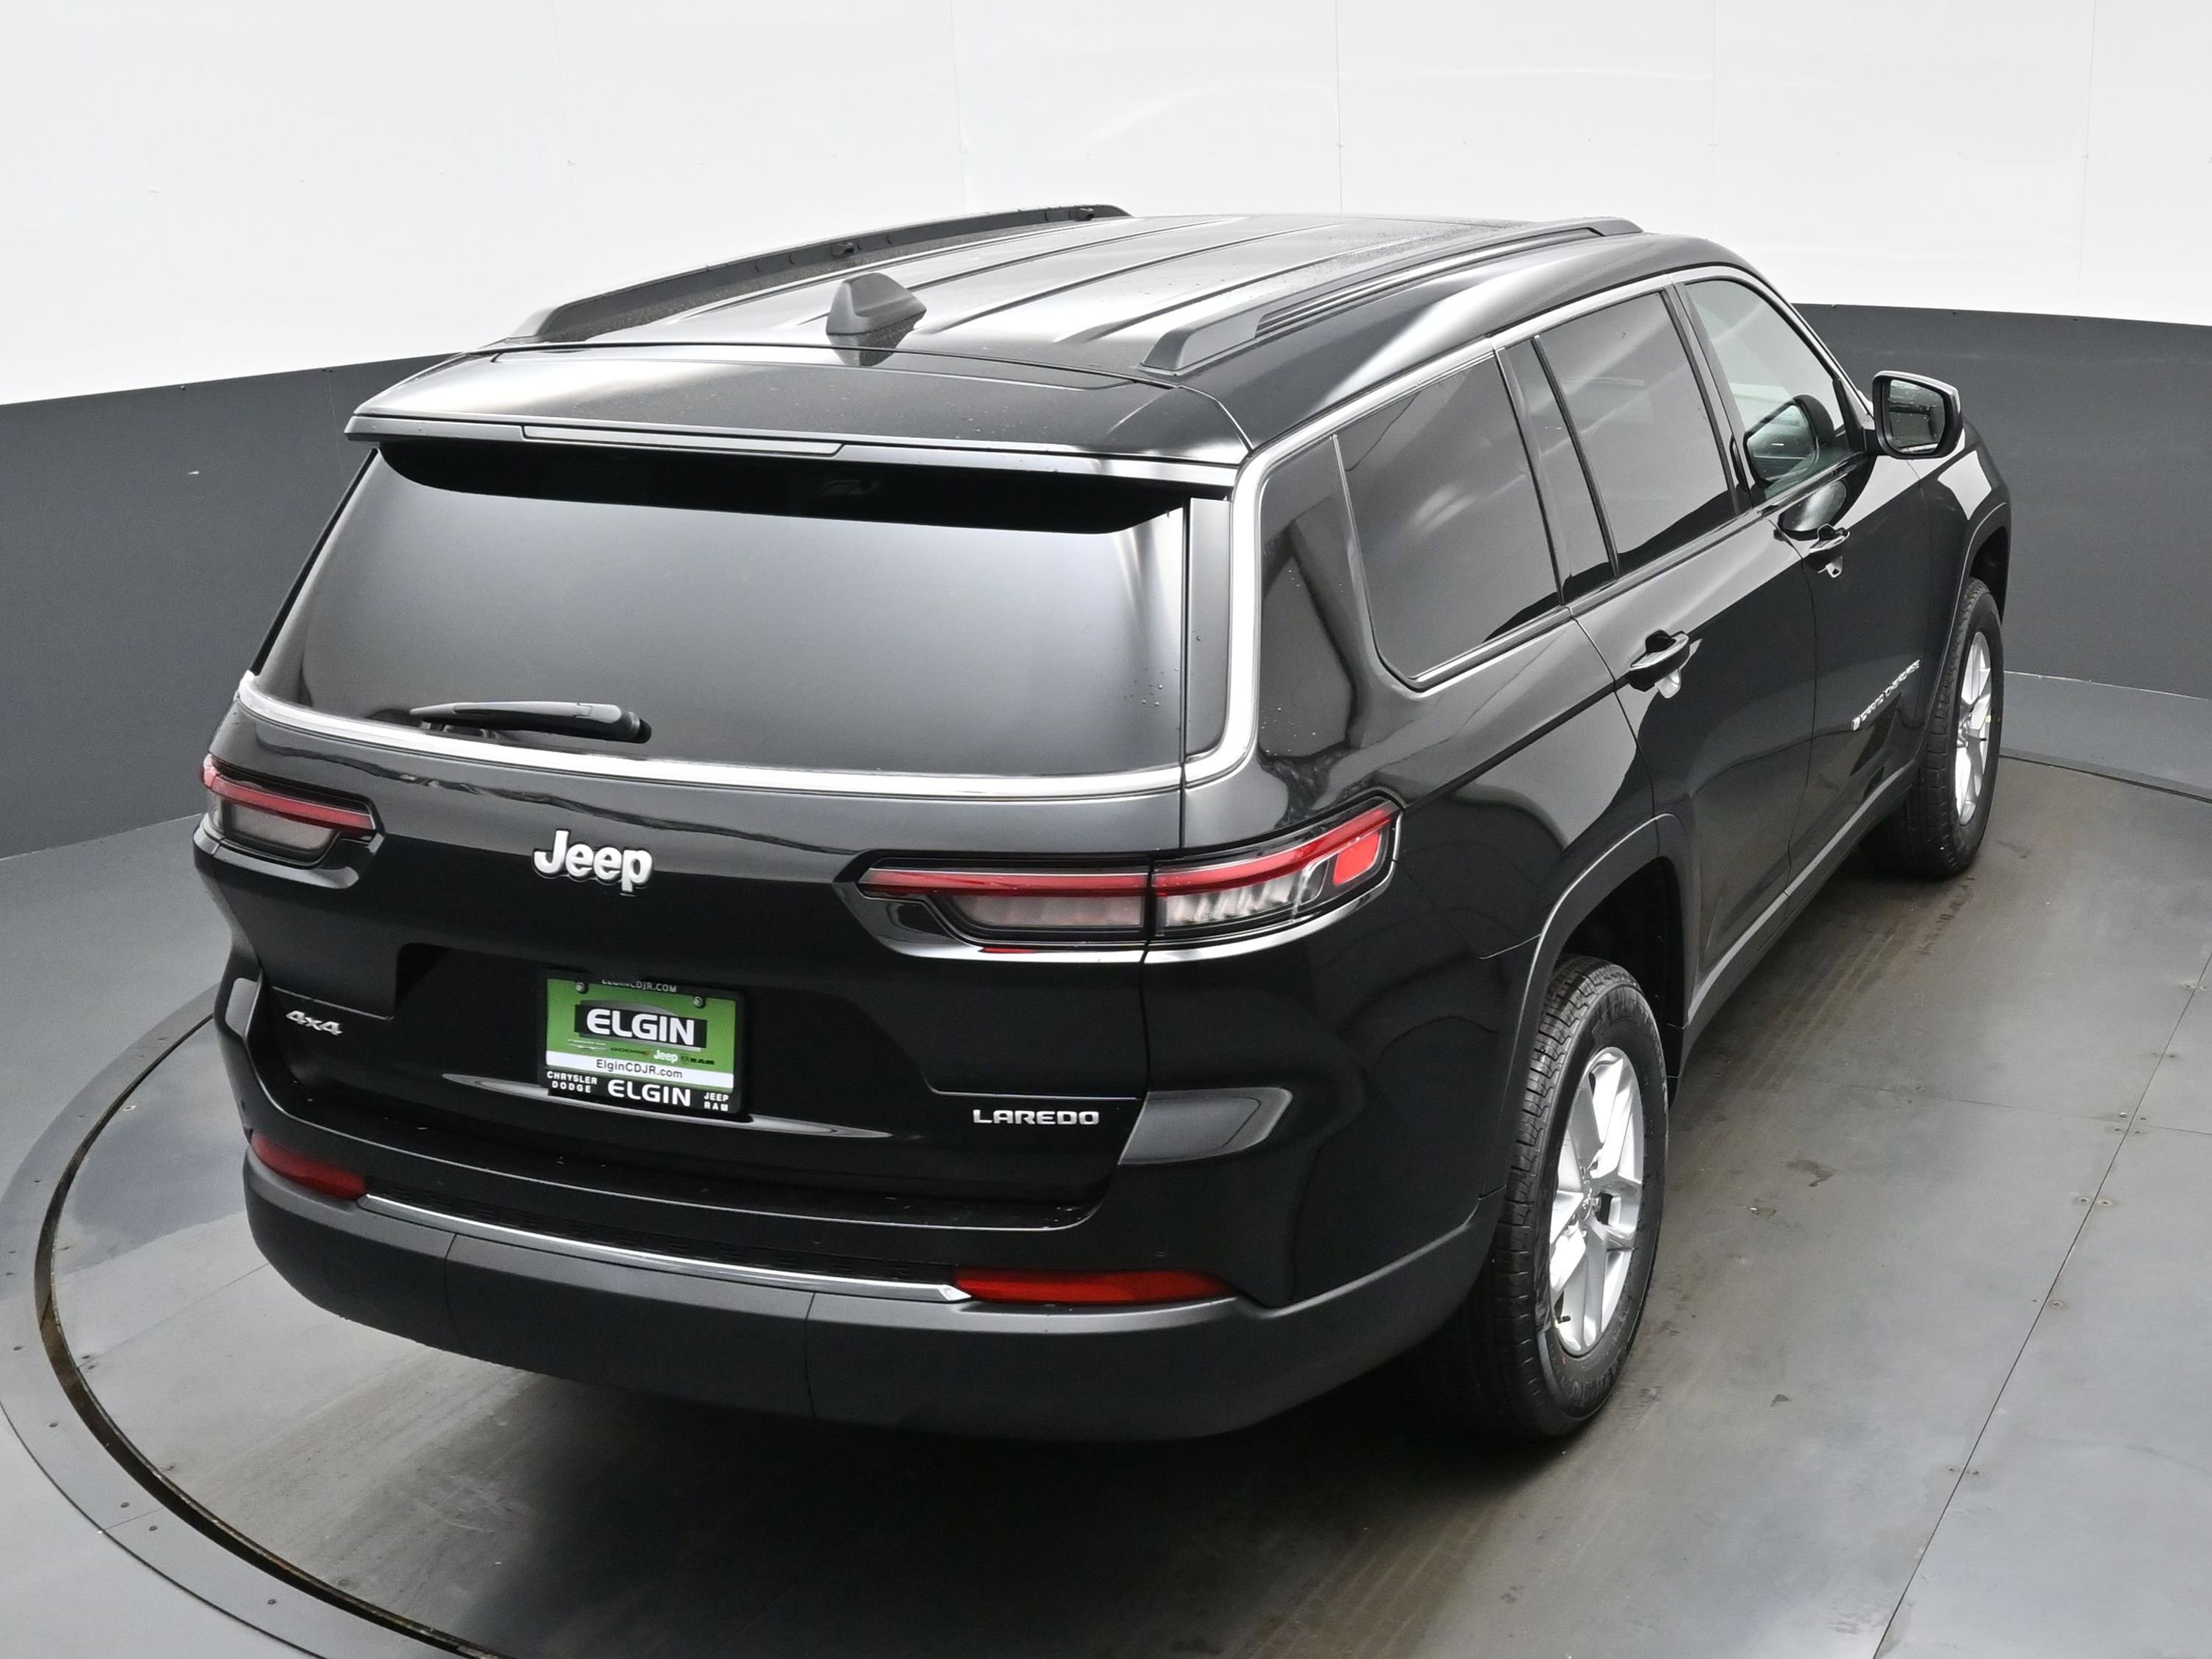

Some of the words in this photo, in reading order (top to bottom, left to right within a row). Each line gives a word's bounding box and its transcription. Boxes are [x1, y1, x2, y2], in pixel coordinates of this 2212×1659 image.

[534, 830, 653, 892] Jeep
[286, 1010, 342, 1036] 4x4
[586, 1008, 695, 1046] ELGIN
[653, 1049, 679, 1063] Jeep
[596, 1059, 683, 1079] ElginCDJR.com
[546, 1071, 597, 1085] CHRYSLER
[552, 1080, 591, 1093] DODGE
[608, 1079, 691, 1107] ELGIN
[704, 1092, 729, 1102] JEEP
[704, 1101, 728, 1112] RAM
[973, 1109, 1099, 1125] LAREDO
